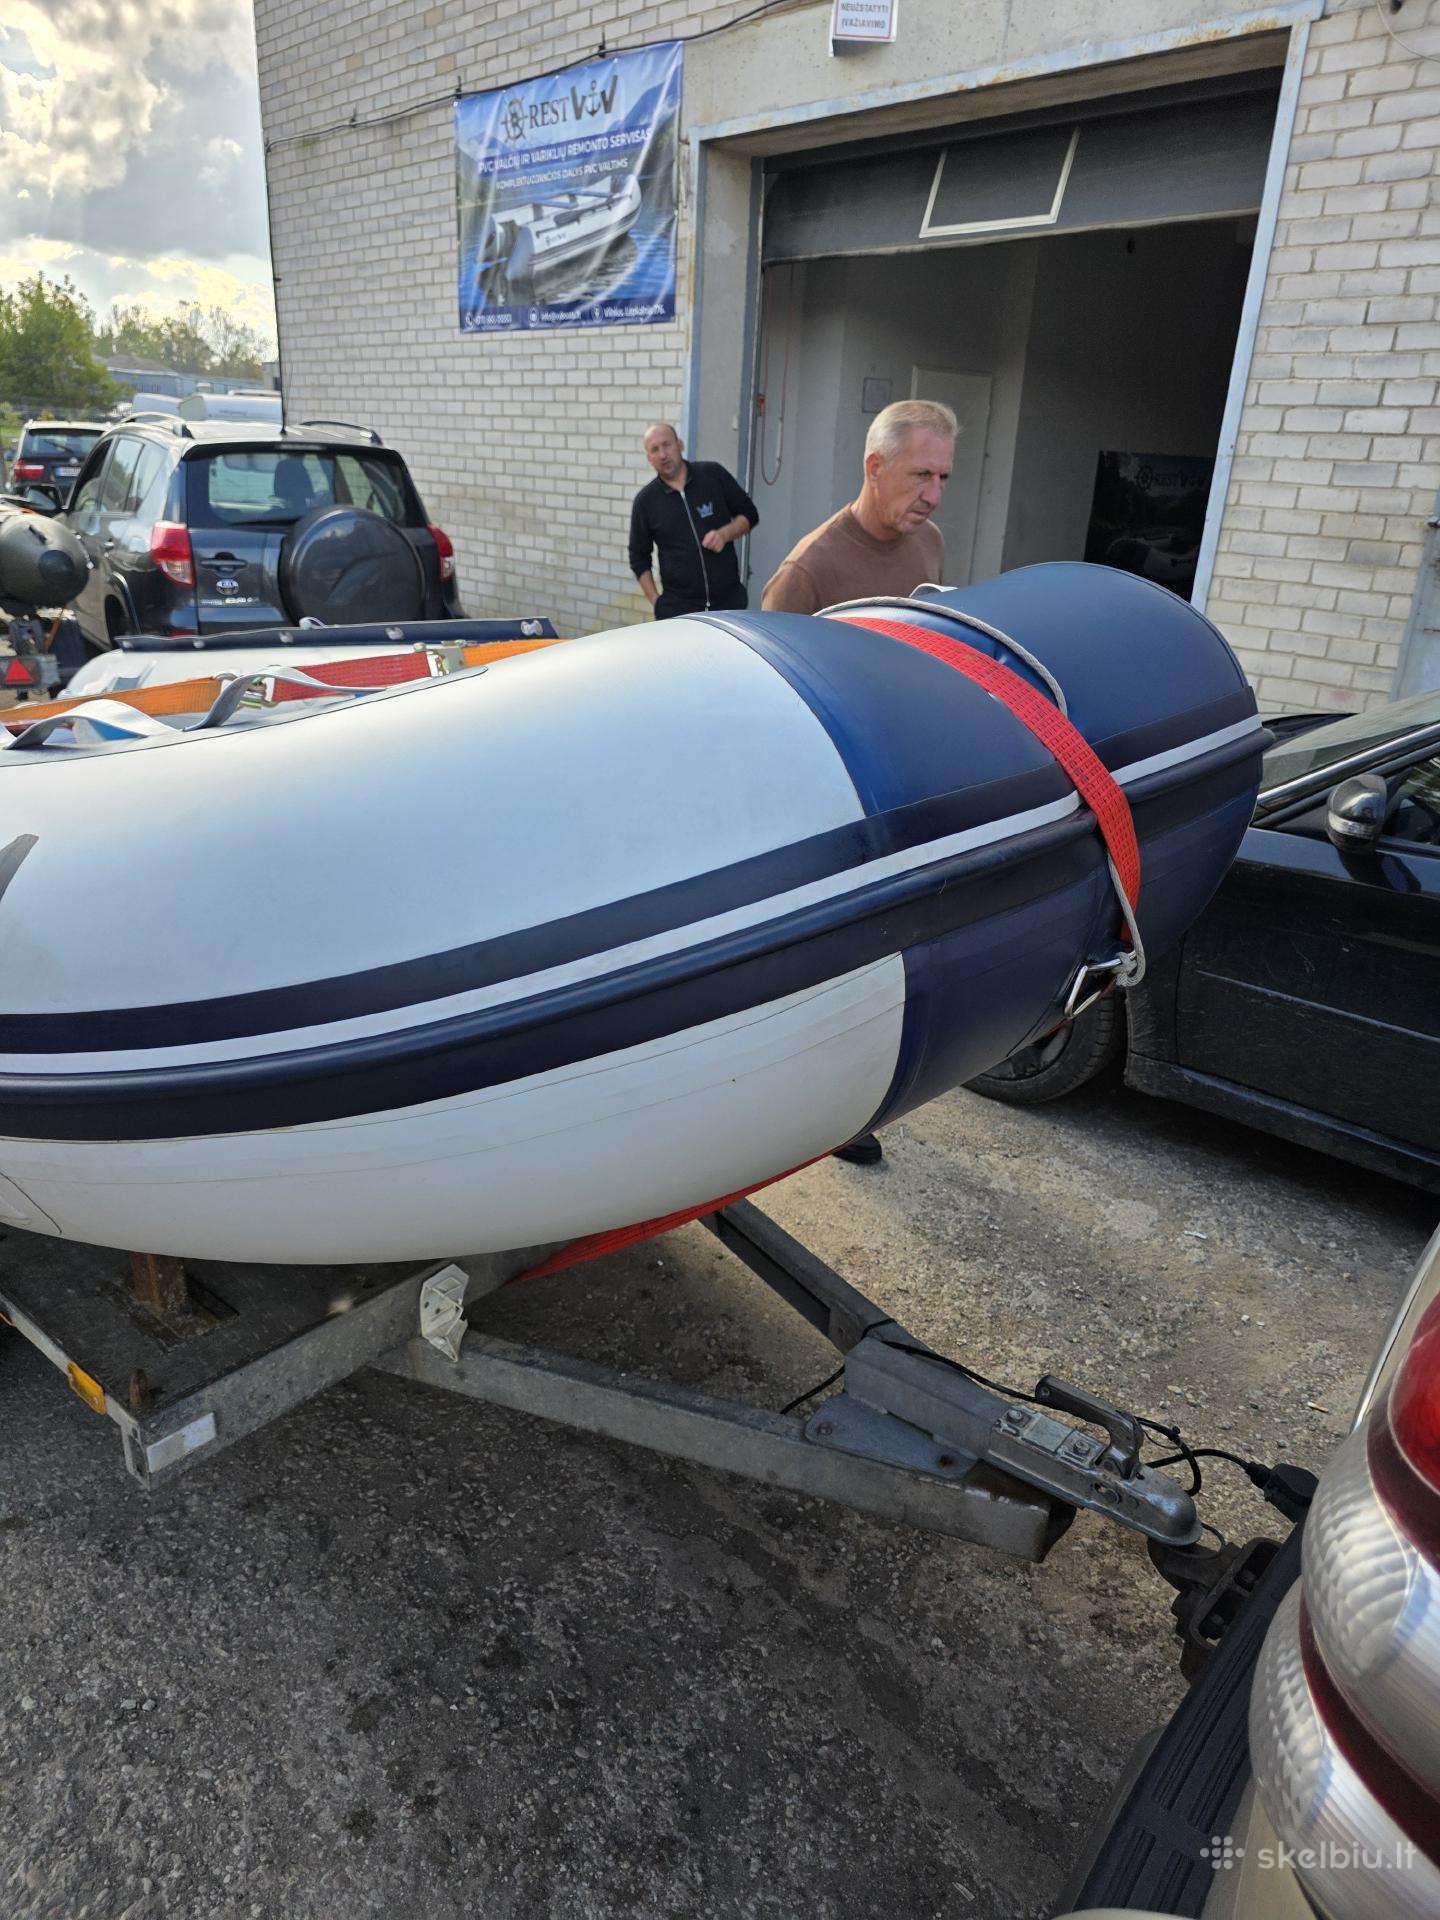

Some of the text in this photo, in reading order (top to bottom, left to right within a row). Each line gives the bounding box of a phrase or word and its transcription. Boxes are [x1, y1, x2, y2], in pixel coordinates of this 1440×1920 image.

[478, 160, 494, 174] PVC
[521, 153, 531, 165] IR
[567, 137, 609, 155] REMONTO
[610, 128, 653, 148] SERVISAS
[584, 163, 598, 174] PVC
